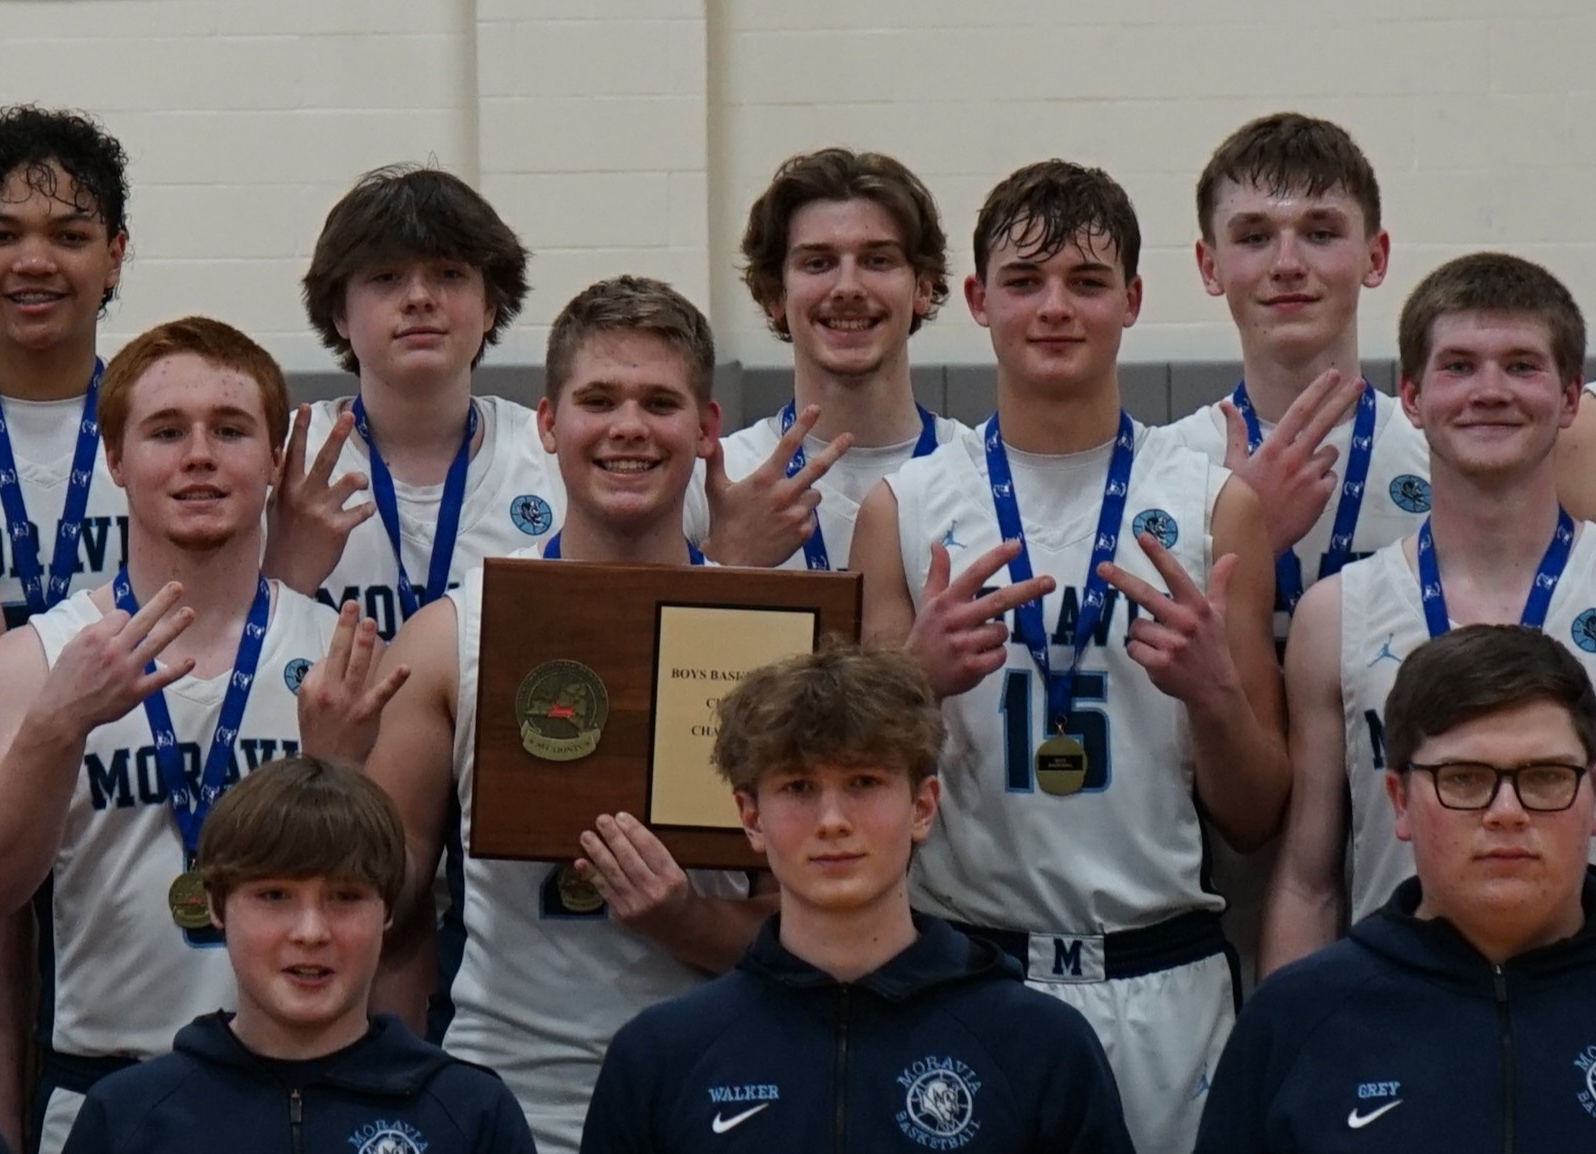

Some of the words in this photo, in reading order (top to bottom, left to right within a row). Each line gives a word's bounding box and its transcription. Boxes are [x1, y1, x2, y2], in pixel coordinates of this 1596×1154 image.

[671, 668, 707, 680] BOYS
[999, 667, 1112, 794] 15
[1052, 937, 1083, 976] M
[708, 1084, 780, 1102] WALKER
[896, 1056, 982, 1096] MORAVIA
[1357, 1080, 1400, 1098] GREY
[348, 1119, 429, 1153] MORAVIA
[895, 1110, 982, 1151] BASKETBALL
